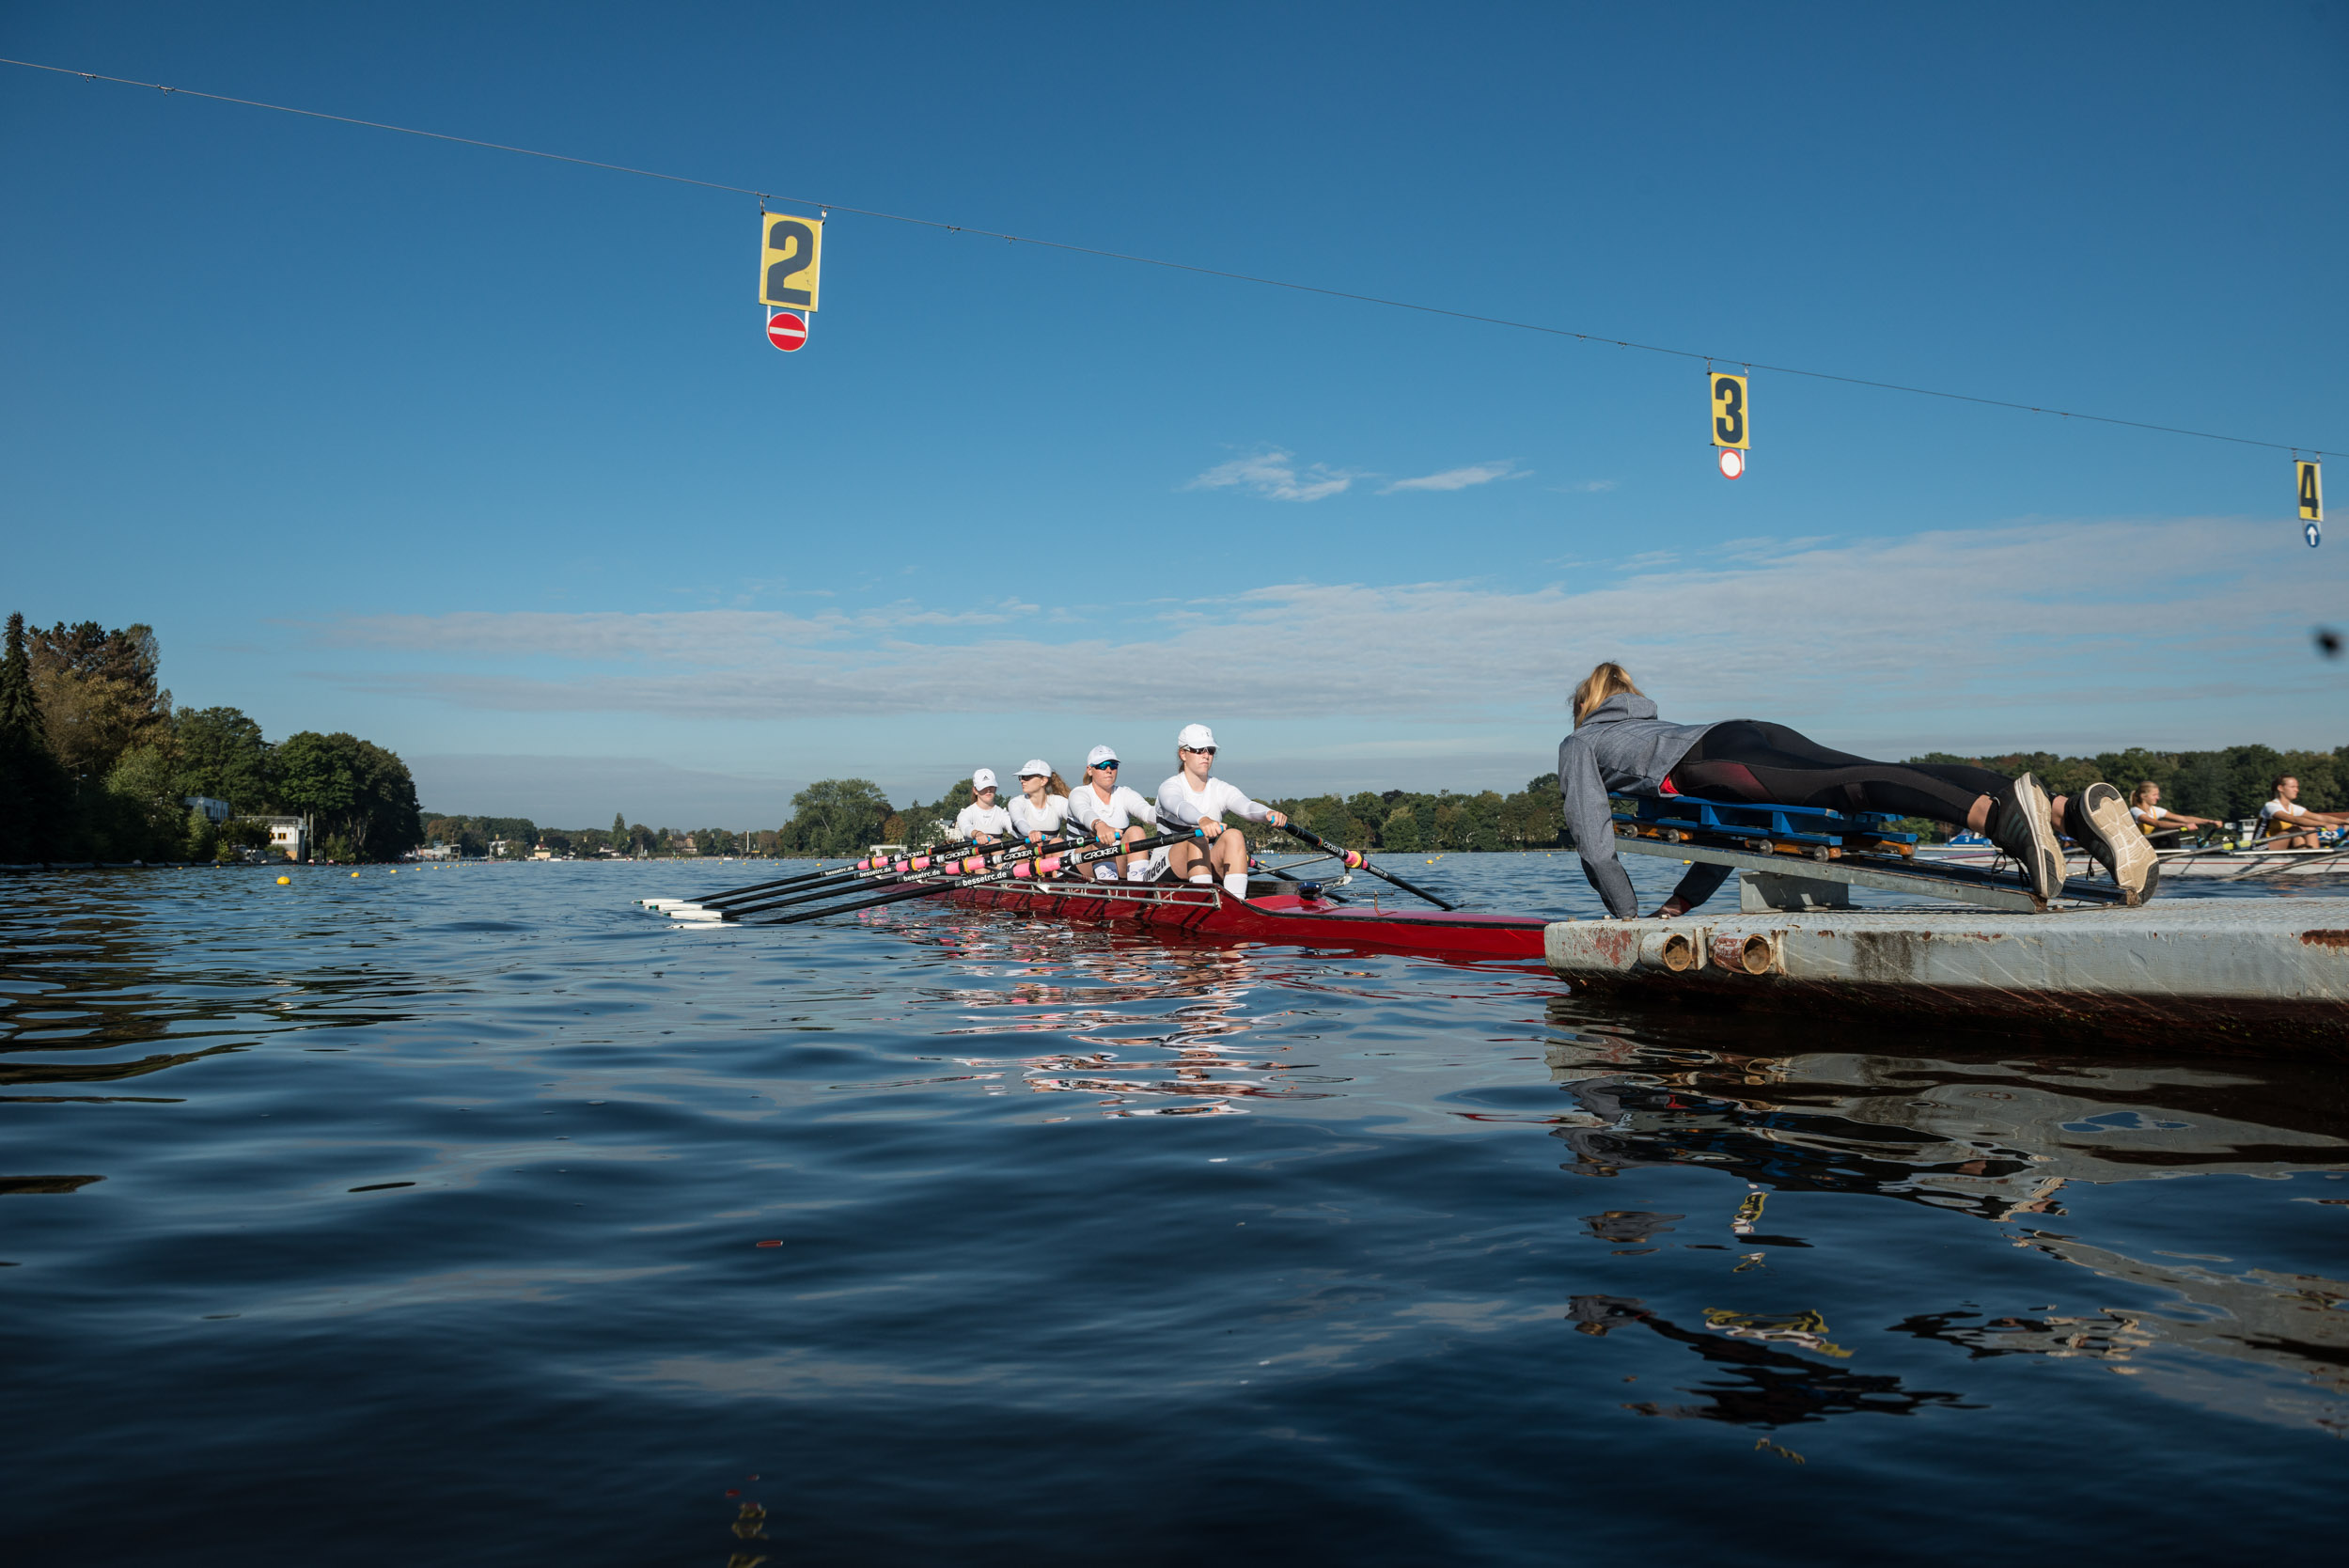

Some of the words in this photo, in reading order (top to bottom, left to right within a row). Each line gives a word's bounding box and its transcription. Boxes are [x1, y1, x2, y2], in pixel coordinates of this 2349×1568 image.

[766, 220, 814, 306] 2
[1715, 377, 1744, 444] 3
[2300, 464, 2319, 518] 4
[946, 850, 971, 860] CROKER
[1003, 849, 1033, 860] CROKER
[1083, 846, 1119, 860] CROKER
[824, 866, 854, 876] besselrc.de
[859, 867, 892, 878] besselrc.de
[902, 870, 941, 882] besselrc.de
[962, 871, 1008, 886] besselrc.de
